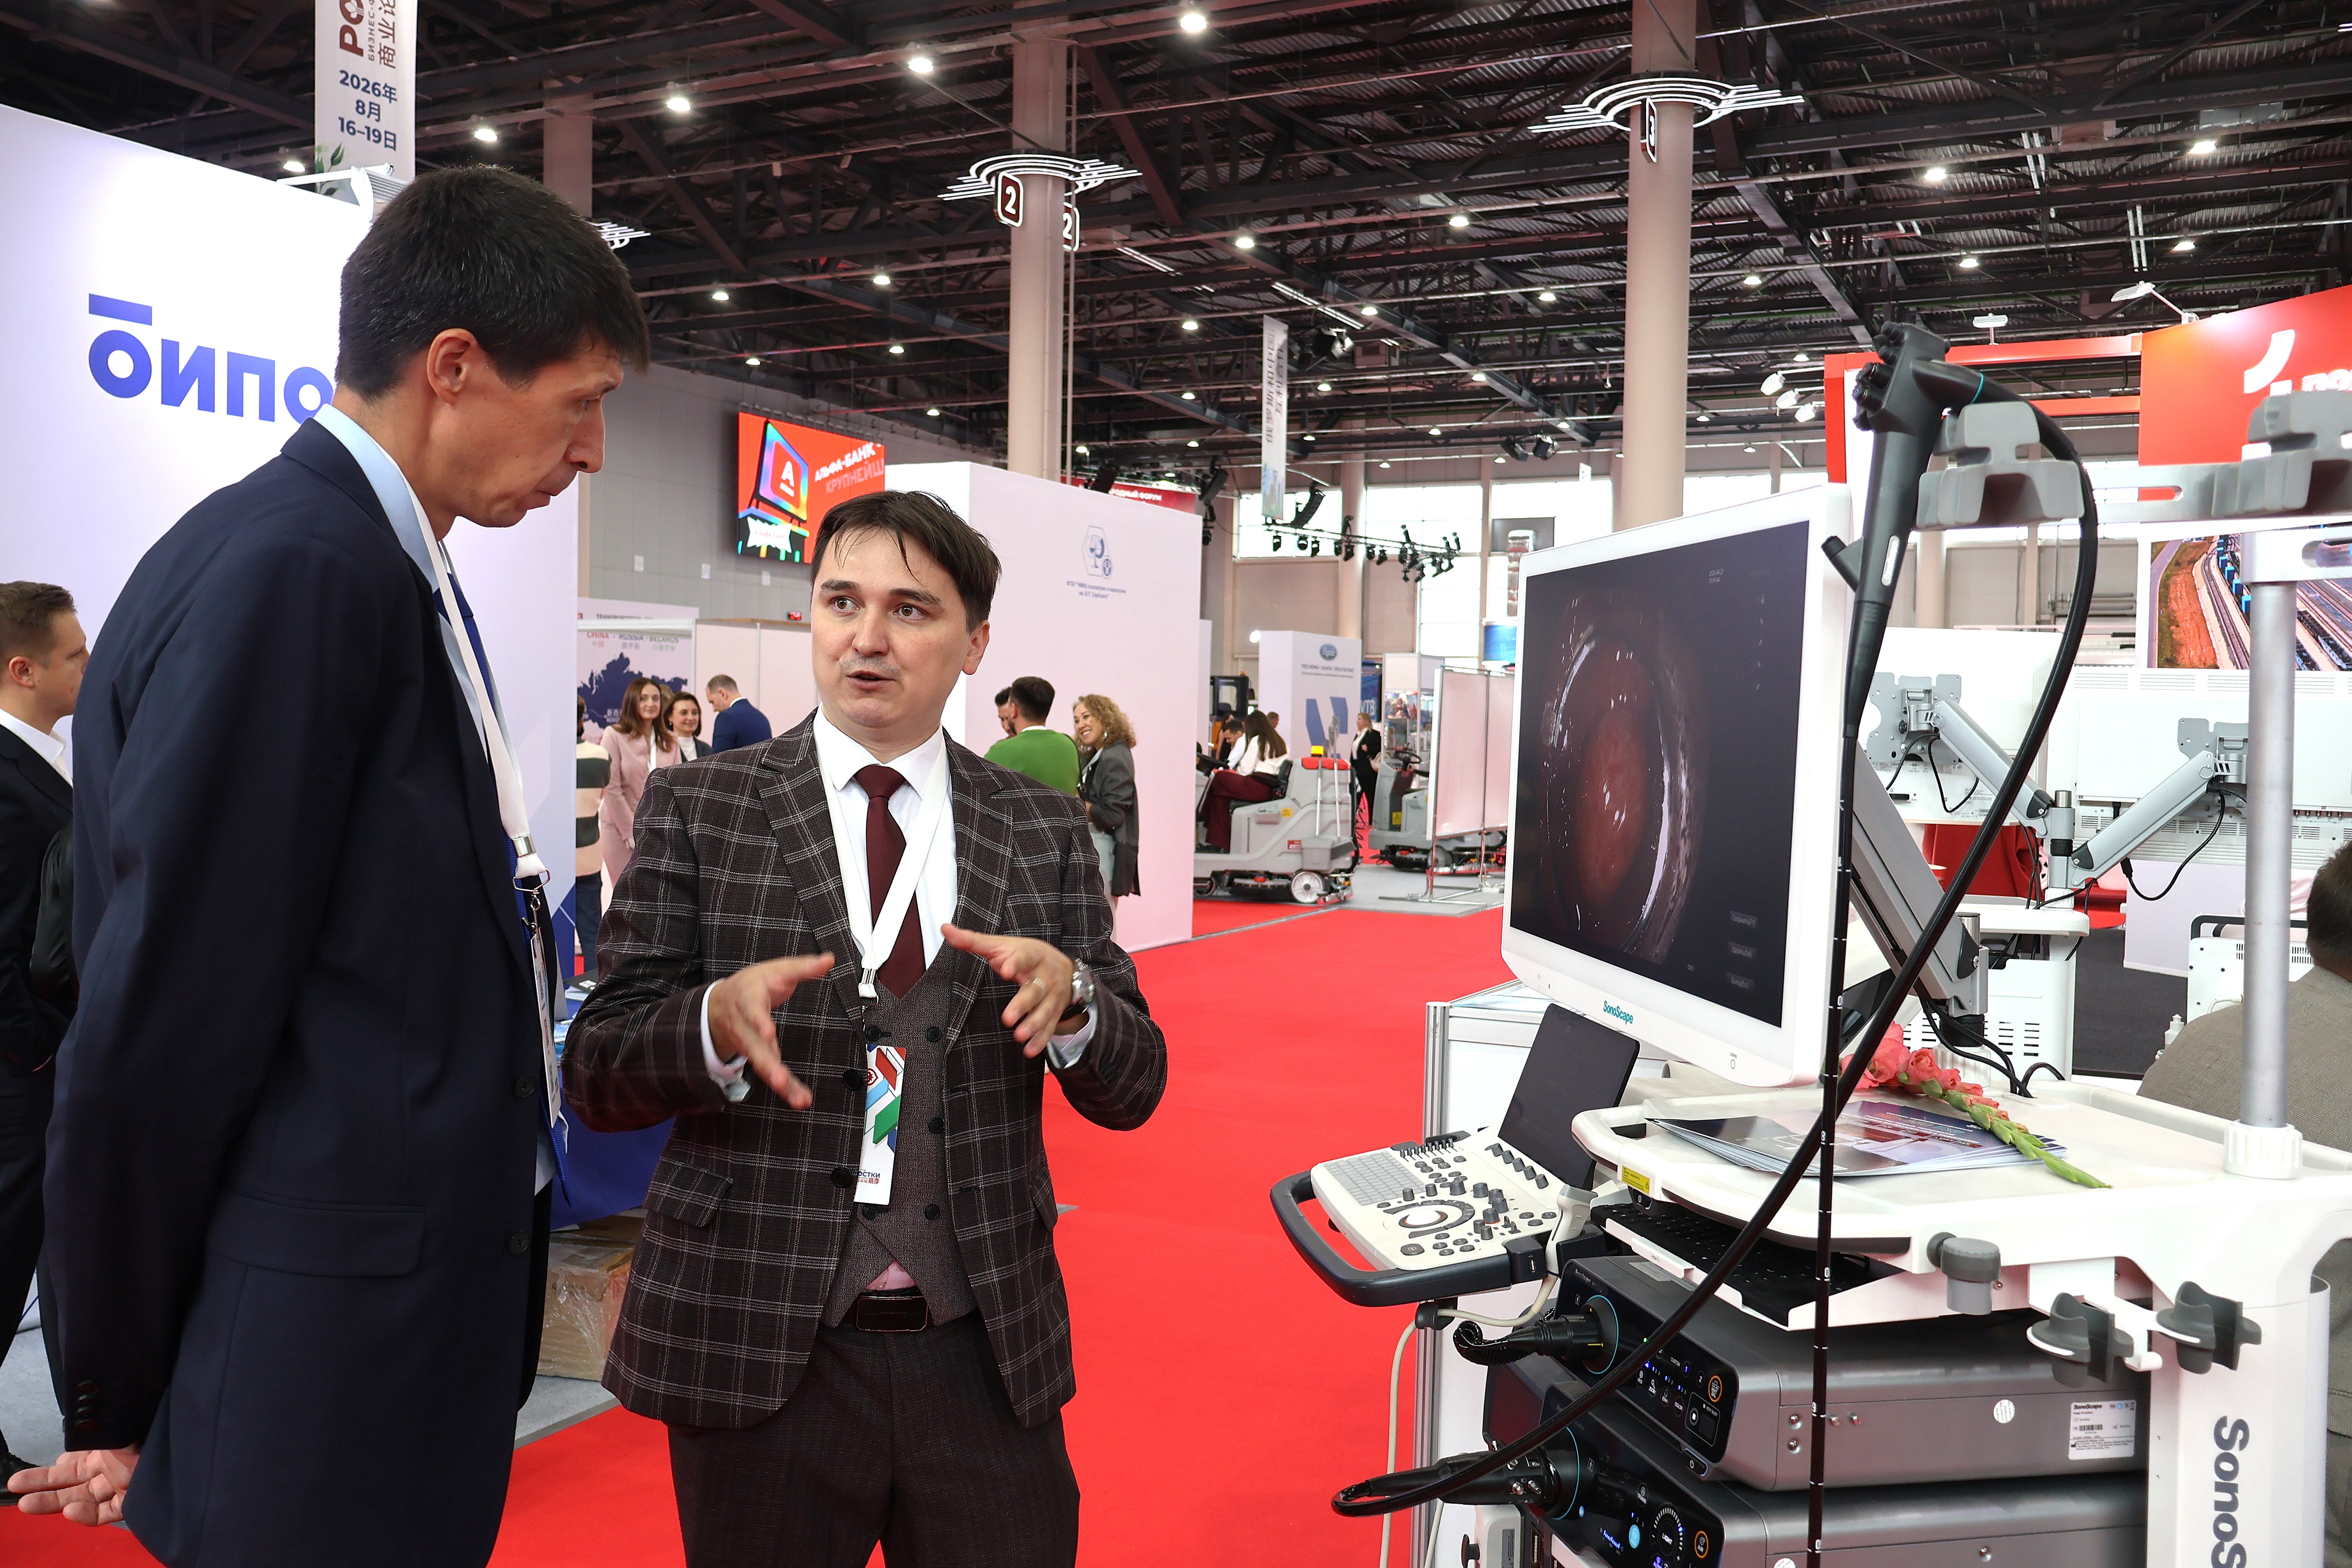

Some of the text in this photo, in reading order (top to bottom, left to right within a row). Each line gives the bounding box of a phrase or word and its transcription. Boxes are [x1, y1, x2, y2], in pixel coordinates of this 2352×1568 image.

[339, 69, 397, 103] 2026年
[356, 99, 381, 122] 8月
[1004, 185, 1016, 215] 2
[1063, 212, 1073, 240] 2
[815, 442, 876, 482] АЛЬФА-БАНК
[826, 458, 885, 494] КРУПНЕЙШ
[1603, 1000, 1633, 1025] SonoScape
[1821, 1131, 1826, 1141] 8
[1675, 1402, 1683, 1411] COLOR
[1812, 1402, 1816, 1413] 9
[1662, 1533, 1673, 1545] LIGHT
